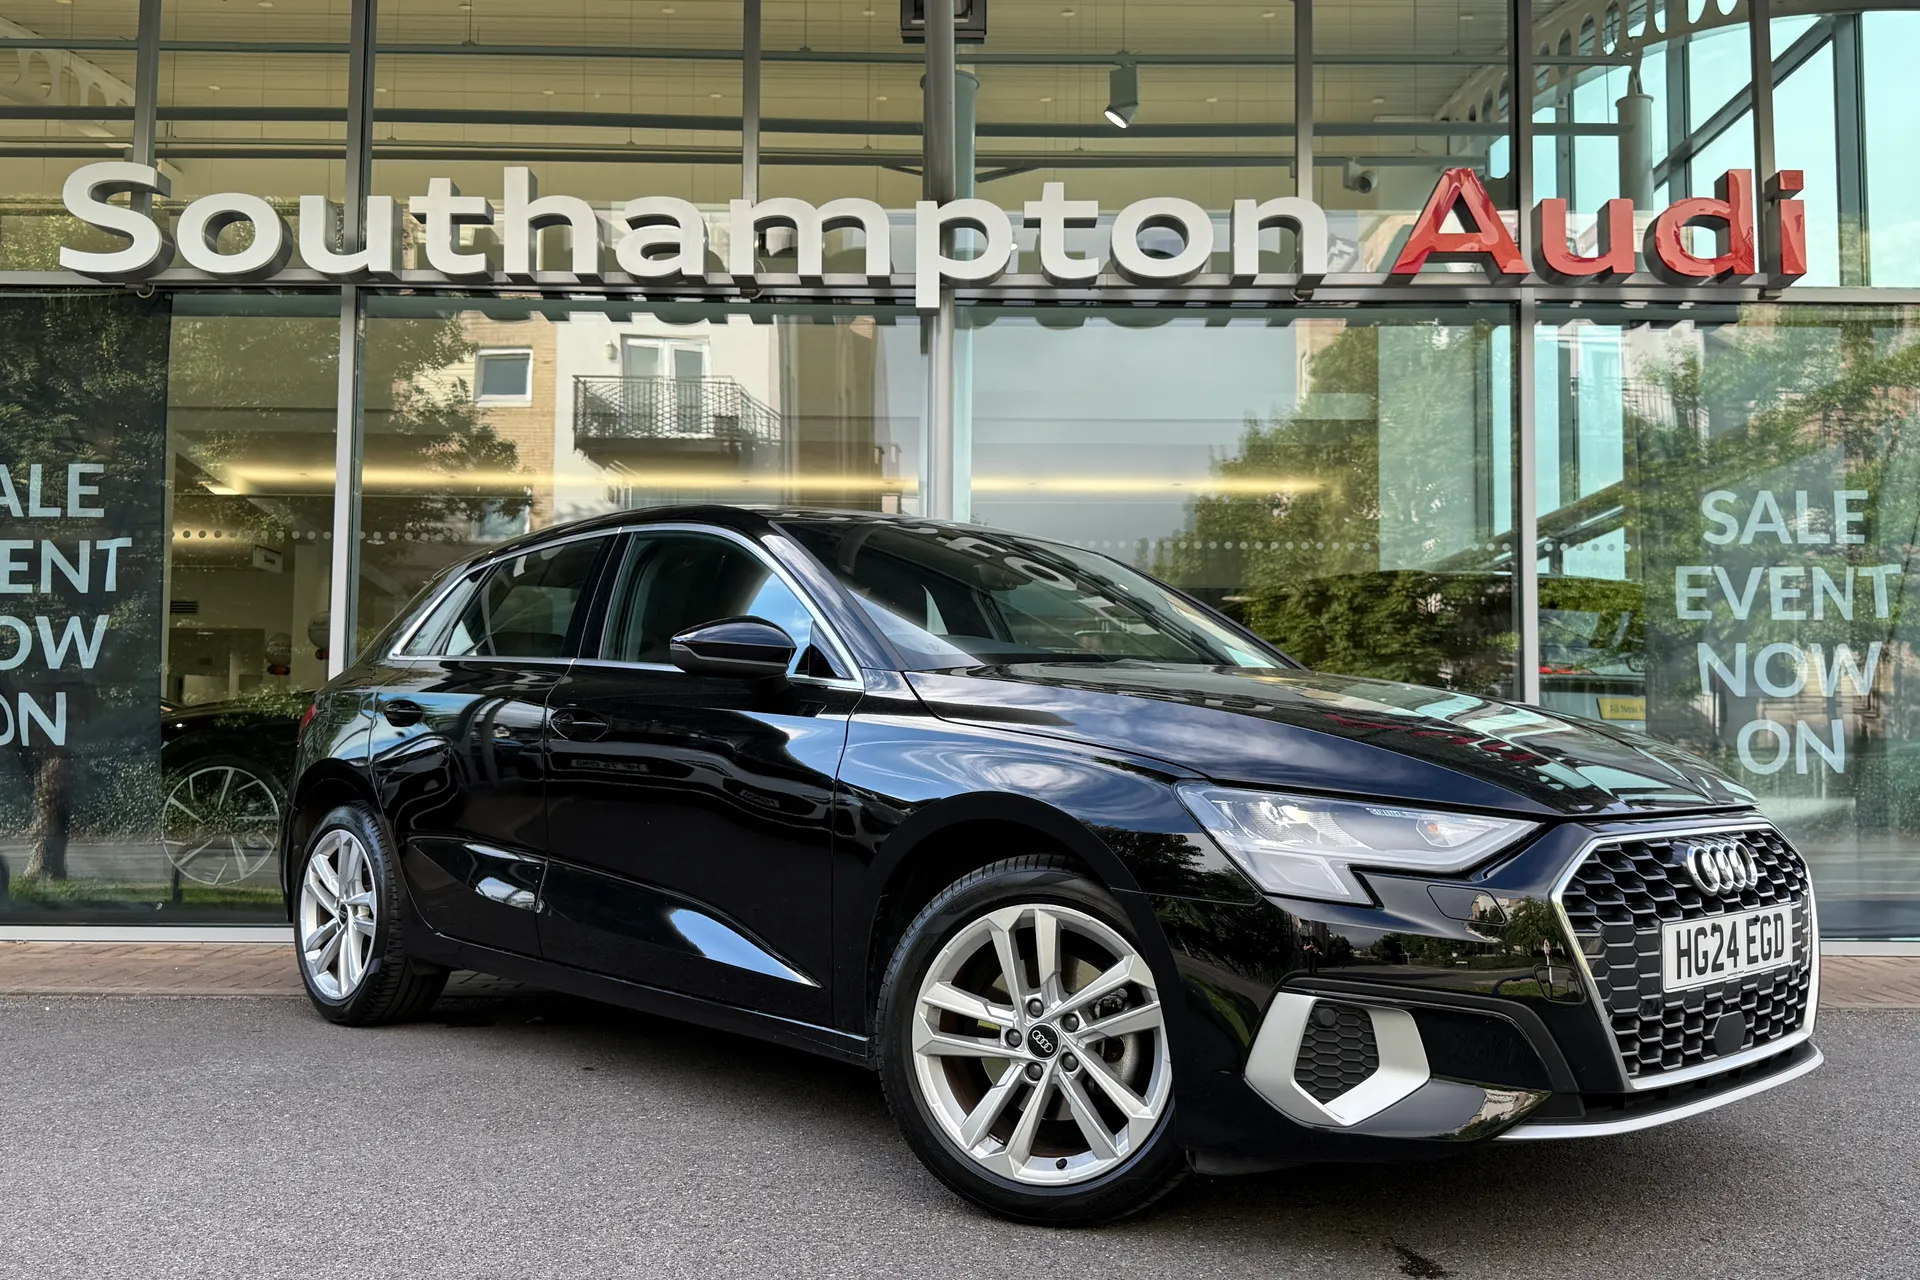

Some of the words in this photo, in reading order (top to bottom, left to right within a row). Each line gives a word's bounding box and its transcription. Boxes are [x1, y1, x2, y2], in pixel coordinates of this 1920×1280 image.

[59, 161, 1330, 308] Southampton
[1390, 167, 1807, 287] Audi
[1701, 490, 1869, 546] SALE
[0, 537, 132, 594] ENT
[1675, 564, 1902, 622] EVENT
[1696, 641, 1883, 698] NOW
[0, 692, 67, 746] N
[1736, 718, 1846, 775] ON
[1675, 920, 1740, 980] HG24
[1745, 912, 1785, 966] EGD
